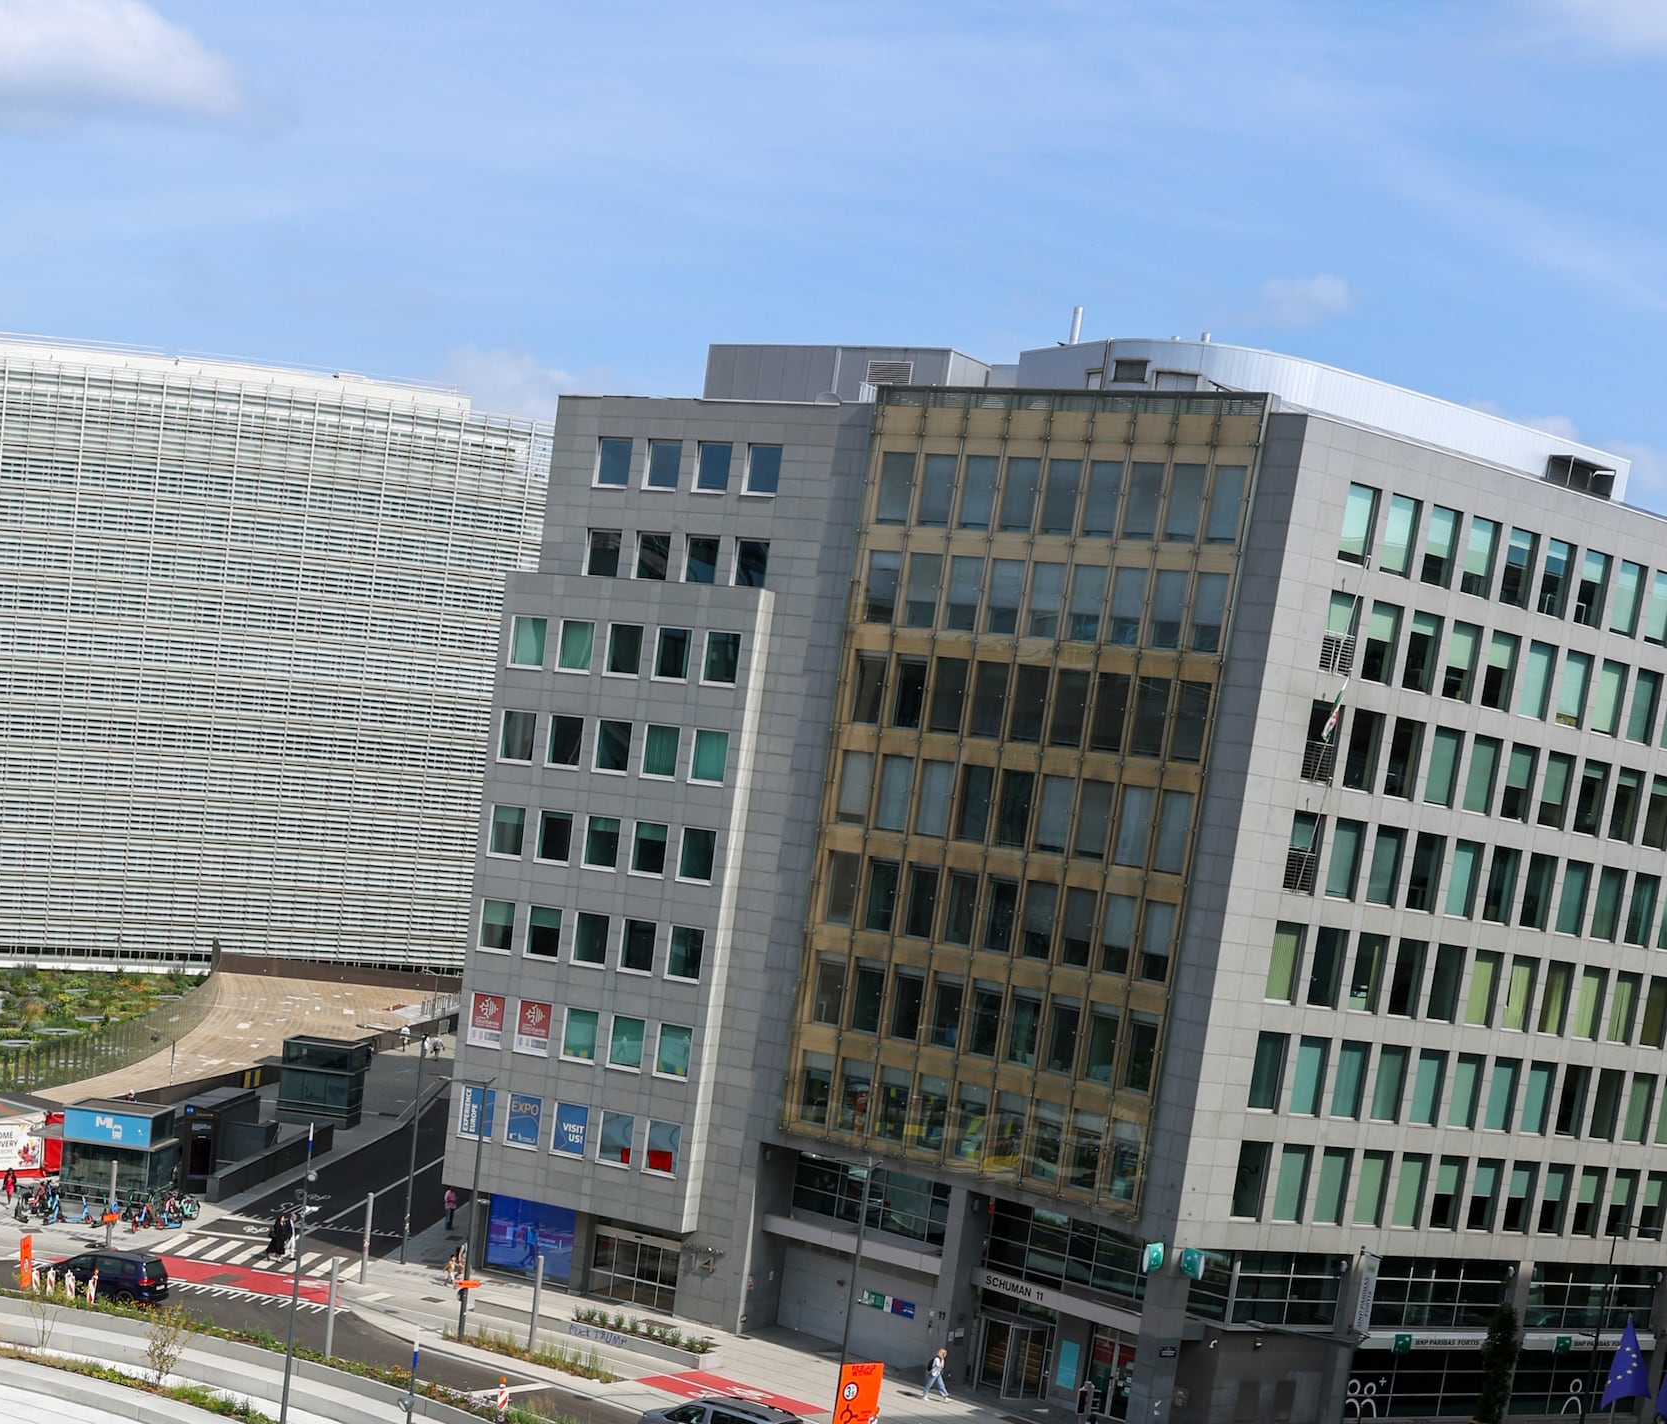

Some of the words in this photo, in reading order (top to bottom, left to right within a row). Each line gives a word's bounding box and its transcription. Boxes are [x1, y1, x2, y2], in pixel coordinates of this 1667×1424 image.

[462, 1087, 472, 1132] EXPERIENCE
[511, 1100, 539, 1116] EXPO
[95, 1115, 113, 1129] M
[469, 1104, 478, 1132] EUROPE
[563, 1122, 585, 1134] VISIT
[568, 1134, 583, 1144] US!
[689, 1253, 716, 1274] 14
[985, 1275, 1033, 1298] SCHUMAN
[1036, 1291, 1044, 1302] 11
[938, 1310, 946, 1321] 11
